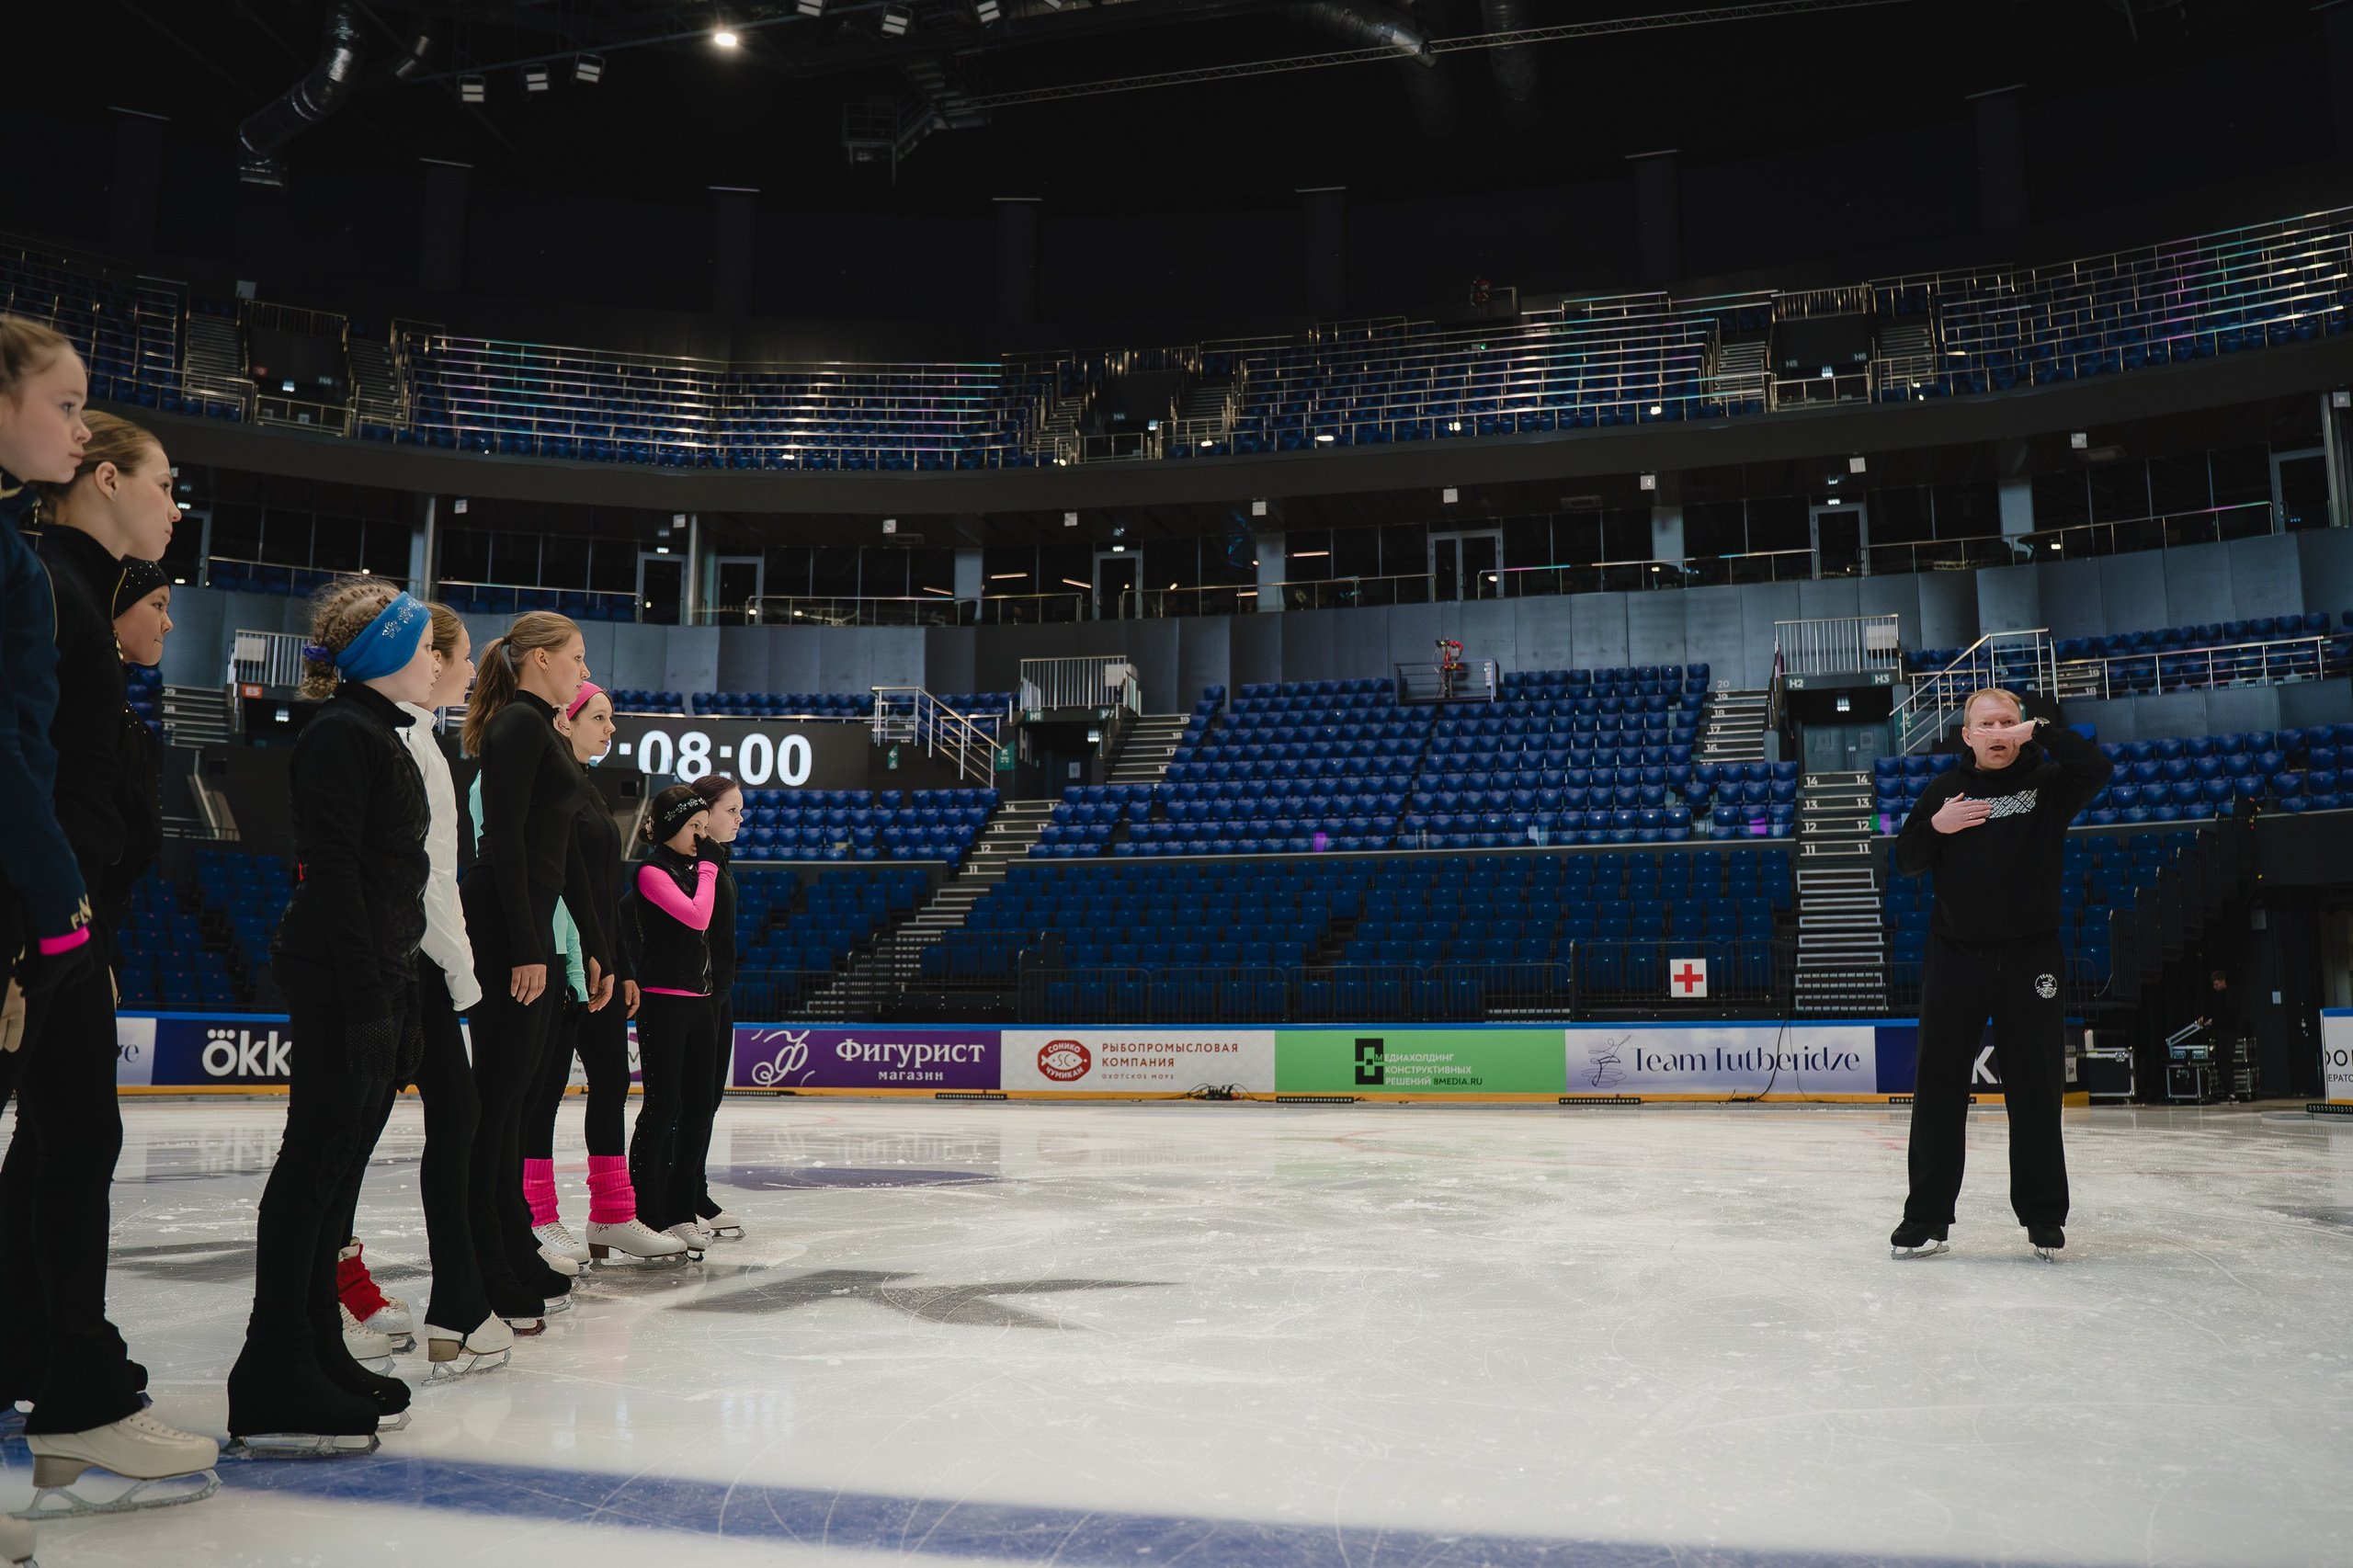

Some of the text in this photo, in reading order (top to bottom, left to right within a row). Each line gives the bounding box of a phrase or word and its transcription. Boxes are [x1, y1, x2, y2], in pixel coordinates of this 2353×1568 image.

[1717, 680, 1730, 689] 20
[1789, 678, 1804, 688] H2
[1874, 674, 1890, 685] H3
[1029, 711, 1041, 722] H1
[1714, 709, 1725, 717] 18
[1180, 716, 1190, 724] 19
[1165, 747, 1176, 756] 17
[1706, 744, 1718, 752] 16
[1806, 776, 1818, 787] 14
[1856, 775, 1869, 785] 14
[1805, 800, 1818, 809] 13
[1857, 798, 1870, 808] 13
[994, 824, 1005, 833] 13
[1804, 822, 1817, 832] 12
[1857, 820, 1870, 831] 12
[980, 845, 992, 854] 12
[1805, 845, 1816, 855] 11
[1858, 843, 1869, 854] 11
[968, 865, 978, 874] 11
[1048, 1042, 1081, 1053] СОНИКО
[1102, 1043, 1239, 1053] РЫБОПРОМЫСЛОВАЯ
[835, 1039, 986, 1069] Фигурист
[1375, 1053, 1454, 1063] МЕДИАХОЛДИНГ
[1631, 1045, 1861, 1072] Team Tutberidze
[1102, 1057, 1175, 1067] КОМПАНИЯ
[1045, 1066, 1085, 1079] ЧУМИКАН
[1384, 1065, 1472, 1074] КОНСТРУКТИВНЫХ
[878, 1071, 944, 1082] магазин
[1386, 1076, 1483, 1085] РЕШЕНИЙ 8MEDIA.RU
